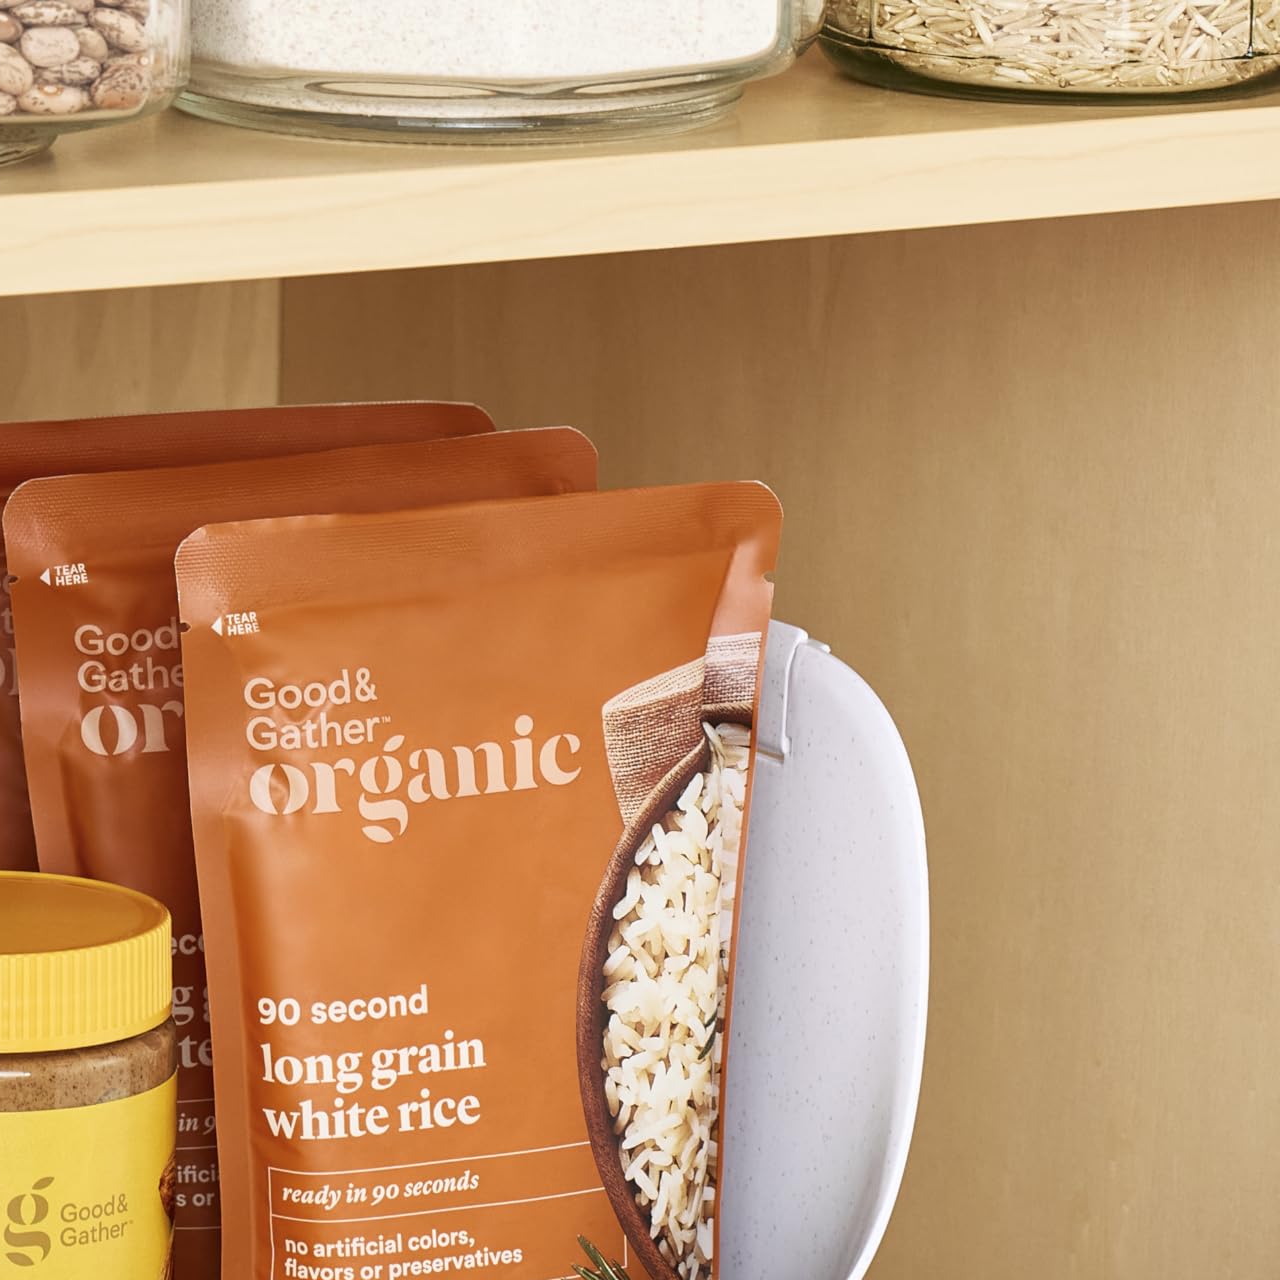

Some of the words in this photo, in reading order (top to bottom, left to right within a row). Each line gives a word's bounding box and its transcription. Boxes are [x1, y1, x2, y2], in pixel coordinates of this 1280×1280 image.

[54, 564, 86, 575] TEAR
[55, 573, 89, 586] HERE
[226, 612, 257, 625] TEAR
[227, 622, 260, 636] HERE
[244, 667, 378, 710] Good&
[249, 714, 582, 843] organic
[258, 998, 301, 1025] 90
[311, 984, 428, 1024] second
[261, 1043, 363, 1093] long
[371, 1029, 487, 1090] grain
[262, 1097, 390, 1139] white
[397, 1088, 481, 1132] rice
[192, 1193, 215, 1207] or
[282, 1185, 341, 1210] ready
[346, 1183, 367, 1203] in
[370, 1183, 399, 1206] 90
[404, 1170, 480, 1197] seconds
[60, 1193, 129, 1223] Good&
[285, 1238, 308, 1255] no
[313, 1233, 402, 1258] artificial
[408, 1229, 475, 1251] colors,
[360, 1264, 382, 1280] or
